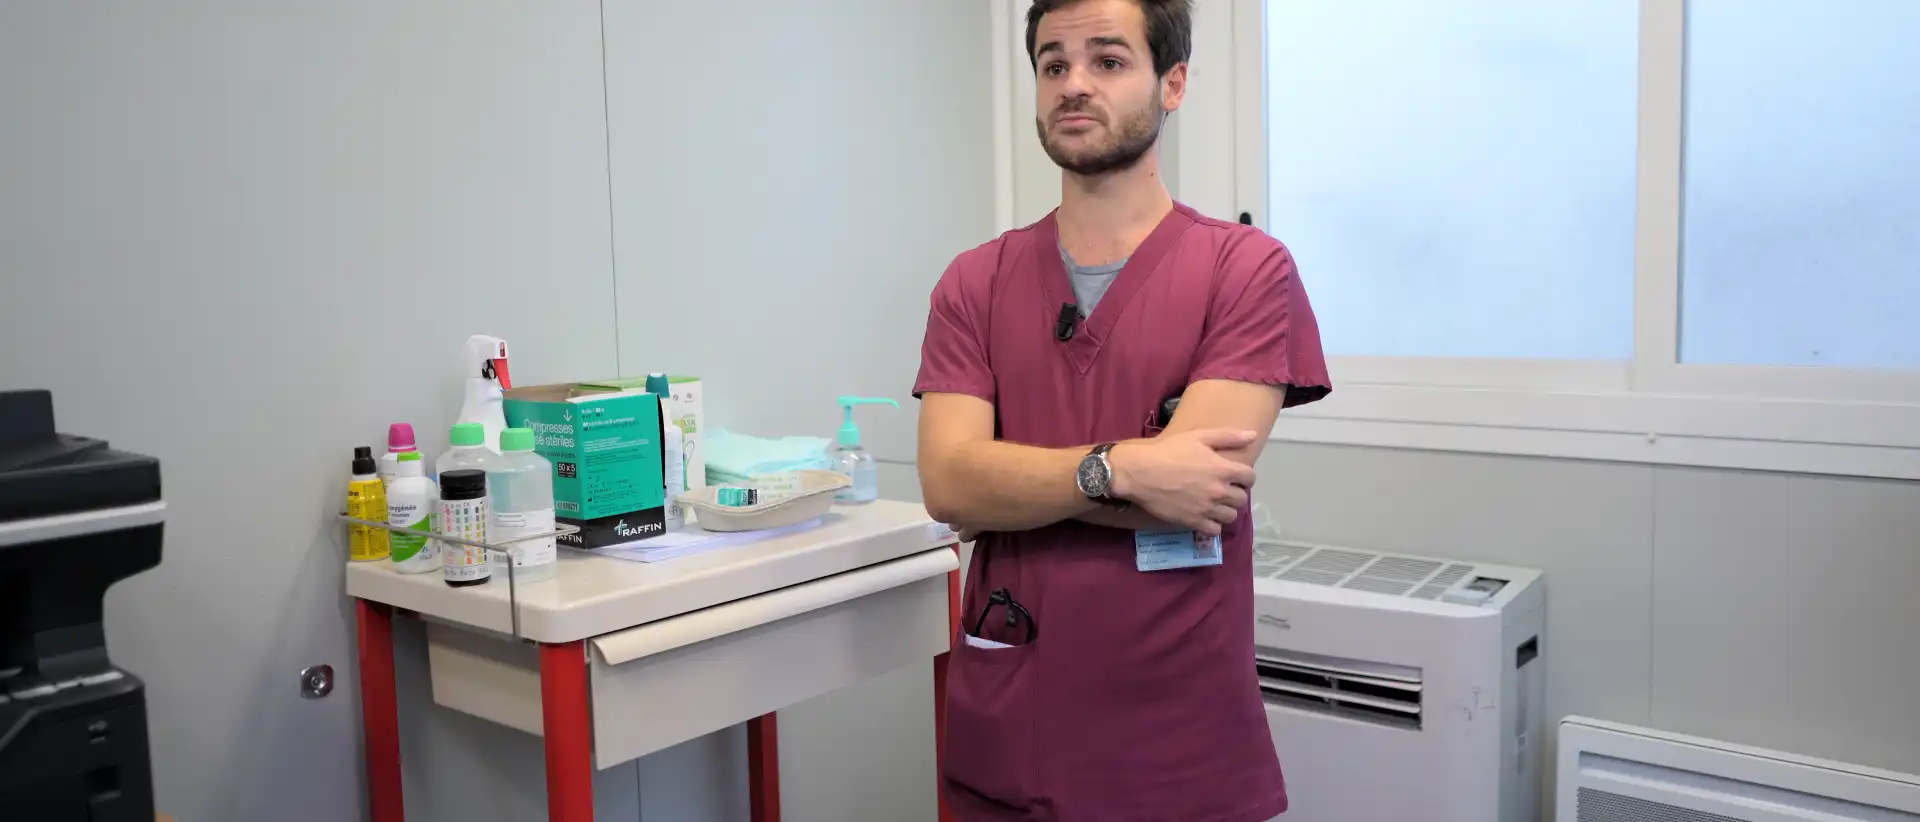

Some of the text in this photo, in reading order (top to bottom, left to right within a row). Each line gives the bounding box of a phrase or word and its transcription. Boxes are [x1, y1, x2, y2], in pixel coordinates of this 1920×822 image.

[545, 435, 575, 448] stériles
[558, 463, 566, 472] 50
[571, 464, 576, 472] 5
[622, 522, 662, 537] RAFFIN
